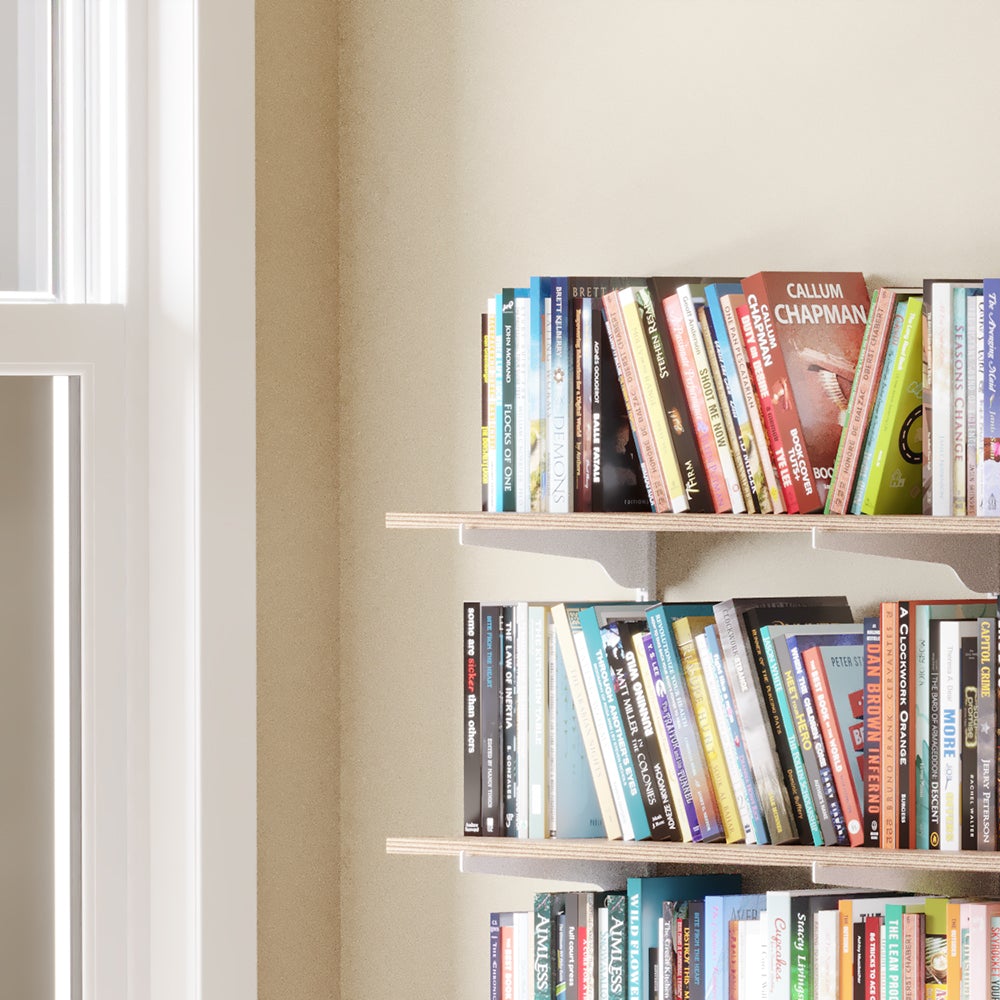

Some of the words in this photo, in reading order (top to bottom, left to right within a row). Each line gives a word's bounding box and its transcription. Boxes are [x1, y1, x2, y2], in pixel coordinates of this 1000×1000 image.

[787, 283, 843, 298] CALLUM
[746, 292, 773, 368] CHAPMAN
[759, 303, 777, 349] CALLUM
[774, 304, 867, 324] CHAPMAN
[954, 325, 964, 390] SEASONS
[698, 368, 716, 403] SHOOT
[504, 404, 513, 445] FLOCKS
[707, 403, 720, 422] ME
[954, 397, 964, 461] CHANGE
[504, 448, 513, 463] OF
[712, 422, 727, 448] NOW
[789, 427, 805, 460] BOOK
[553, 415, 565, 504] DEMONS
[796, 459, 813, 496] COVER
[504, 471, 513, 492] ONE
[467, 608, 475, 636] some
[505, 621, 513, 642] THE
[900, 606, 908, 618] A
[467, 639, 475, 656] are
[505, 645, 513, 669] LAW
[867, 643, 880, 680] DAN
[981, 621, 990, 664] CAPITOL
[467, 658, 476, 693] sicker
[624, 650, 640, 681] WILD
[899, 624, 909, 706] CLOCKWORK
[981, 666, 990, 698] CRIME
[467, 695, 476, 718] than
[505, 688, 513, 729] INERTIA
[594, 648, 614, 703] THROUGH
[608, 704, 630, 766] ANOTHER'S
[624, 767, 638, 796] EYES
[631, 681, 654, 737] RUNNING
[784, 670, 799, 700] MEET
[794, 713, 813, 752] HERO
[810, 670, 824, 693] BEST
[817, 693, 831, 721] BOOK
[828, 738, 843, 772] WORLD
[867, 683, 880, 742] BROWN
[467, 720, 476, 753] others
[614, 666, 630, 697] MATT
[622, 697, 640, 736] MILLER
[636, 751, 658, 806] COLONIES
[899, 710, 909, 765] ORANGE
[944, 709, 956, 758] MORE
[867, 747, 880, 814] INFERNO
[982, 759, 990, 789] JERRY
[931, 781, 939, 824] DESCENT
[982, 791, 990, 843] PETERSON
[630, 894, 639, 936] WILD
[795, 913, 806, 951] Stacey
[888, 919, 899, 942] THE
[536, 912, 550, 991] AIMLESS
[609, 916, 624, 994] AIMLESS
[769, 917, 787, 982] Cupcakes
[888, 944, 899, 972] LEAN
[991, 927, 1000, 977] SKYROCKET
